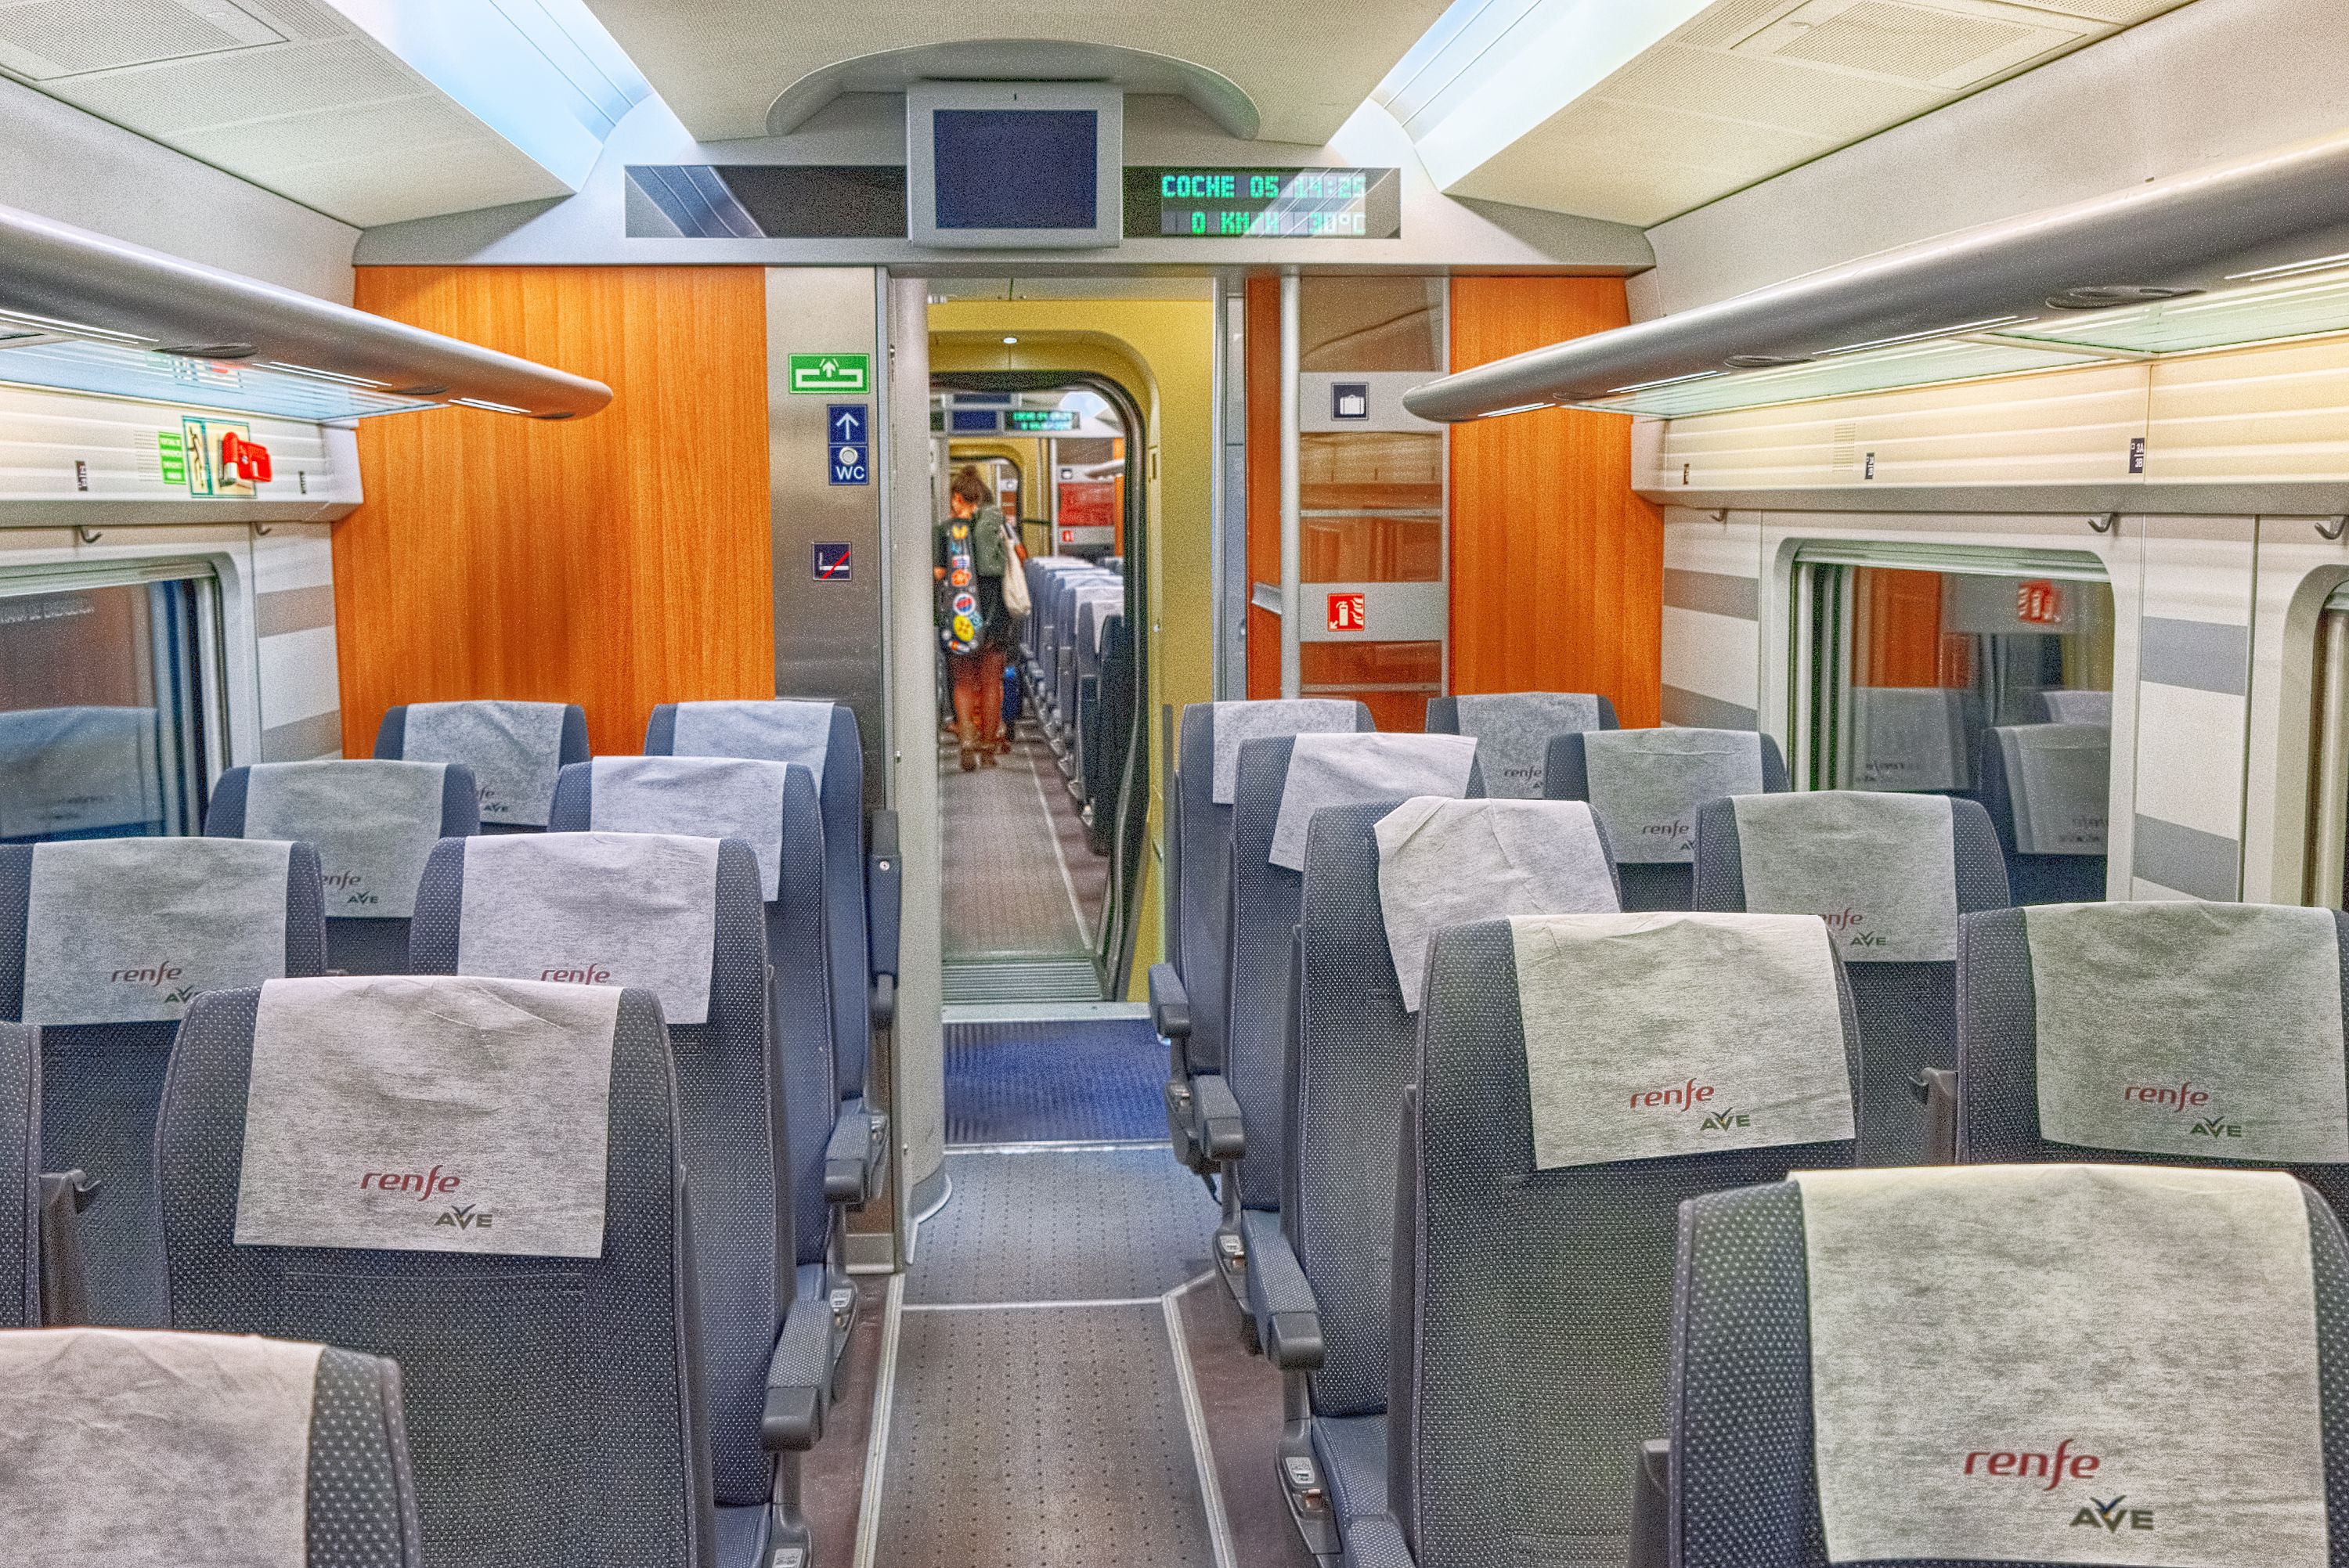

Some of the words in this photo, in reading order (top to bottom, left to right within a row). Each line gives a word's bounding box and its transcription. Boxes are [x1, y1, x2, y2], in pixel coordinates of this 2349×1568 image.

[1161, 175, 1235, 198] COCHE
[1250, 175, 1279, 198] 05
[1294, 175, 1366, 199] 14:25
[1191, 211, 1206, 234] 0
[1220, 211, 1279, 234] KM/H
[835, 466, 864, 480] WC
[1504, 766, 1543, 782] renfe
[1642, 820, 1690, 839] renfe
[321, 870, 361, 891] enfe
[346, 890, 379, 904] AVE
[1849, 930, 1887, 948] AVE
[111, 961, 182, 987] renfe
[540, 962, 612, 986] renfe
[1629, 1077, 1715, 1112] renfe
[2116, 1081, 2210, 1113] renfe
[1699, 1106, 1751, 1133] AVE
[2189, 1115, 2243, 1140] AVE
[359, 1164, 461, 1202] renfe
[433, 1203, 493, 1231] AVE
[1963, 1438, 2101, 1492] renfe
[2068, 1494, 2155, 1534] AVE
